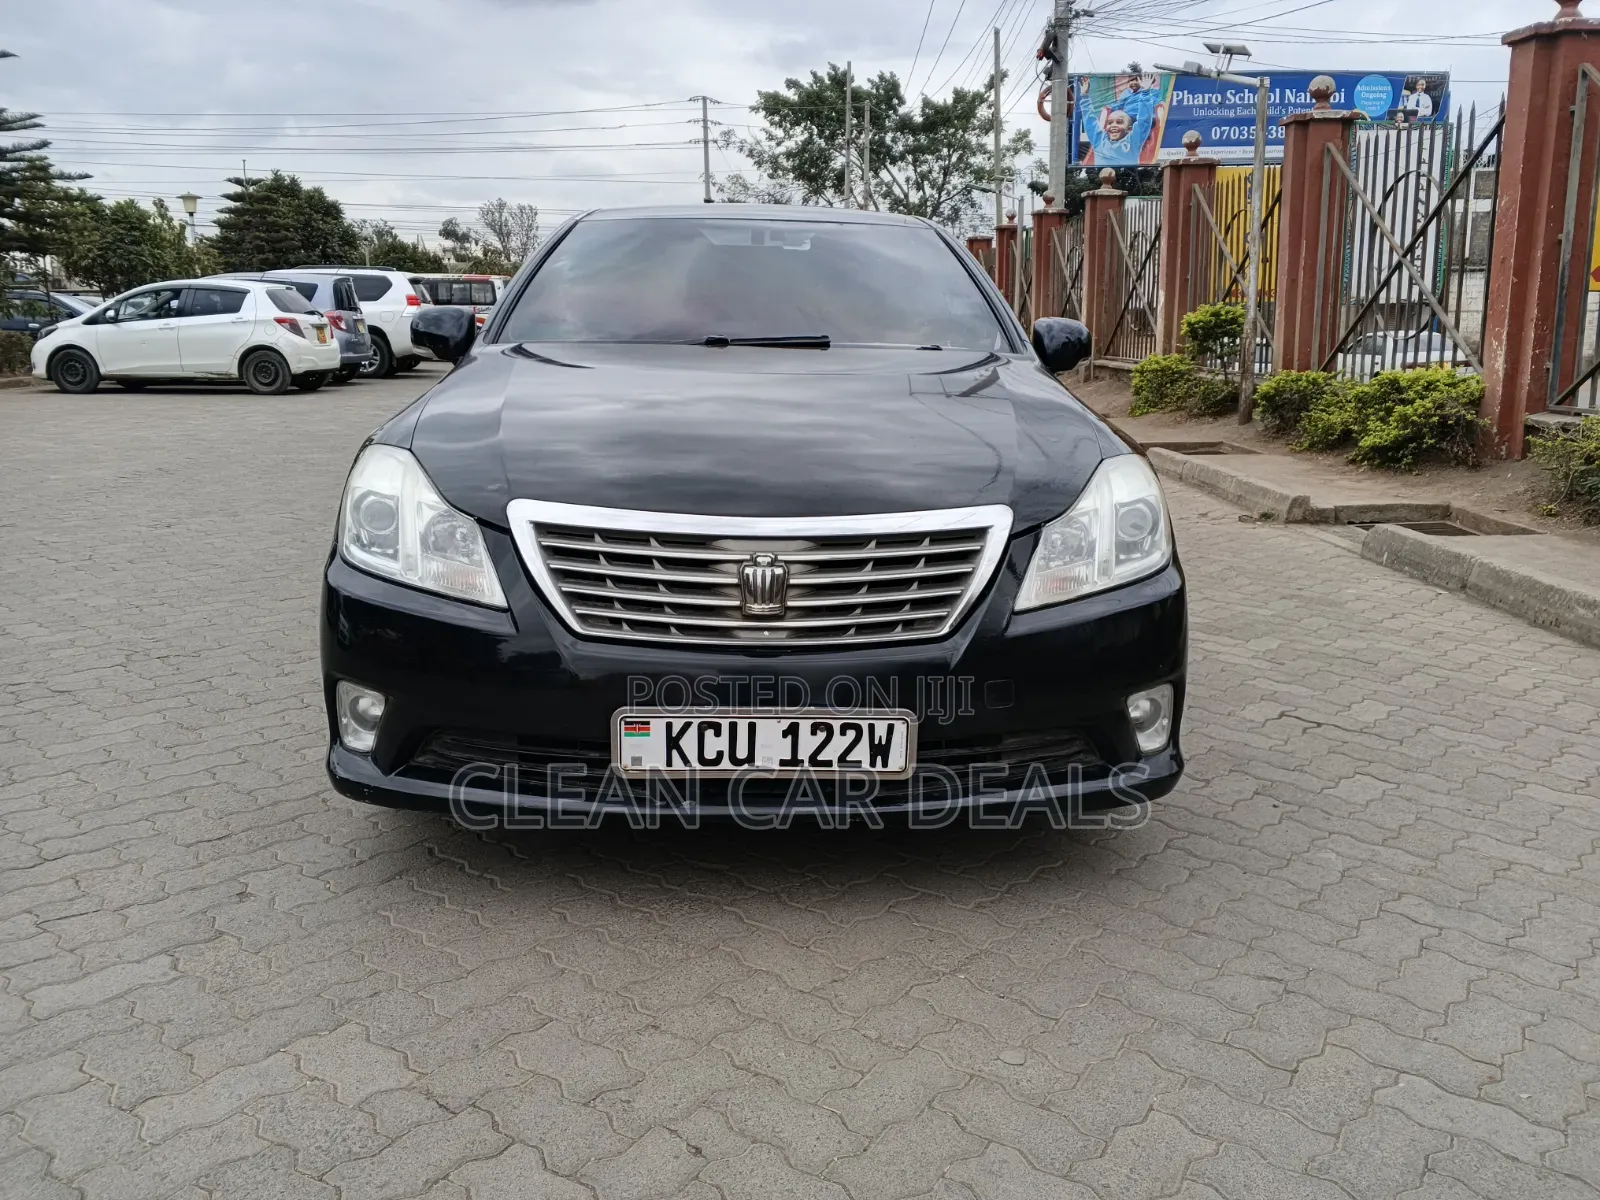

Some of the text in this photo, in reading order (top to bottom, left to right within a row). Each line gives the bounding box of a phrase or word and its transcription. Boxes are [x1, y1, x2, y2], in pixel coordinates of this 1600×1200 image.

[1171, 90, 1221, 105] Pharo
[1284, 88, 1345, 104] Naibi
[1361, 91, 1387, 99] Ongoing
[1193, 107, 1235, 117] Unlocking
[1237, 106, 1257, 115] Each
[1266, 106, 1286, 115] ild's
[1211, 126, 1286, 140] 0703538
[665, 721, 757, 768] KCU
[778, 721, 895, 768] 122W
